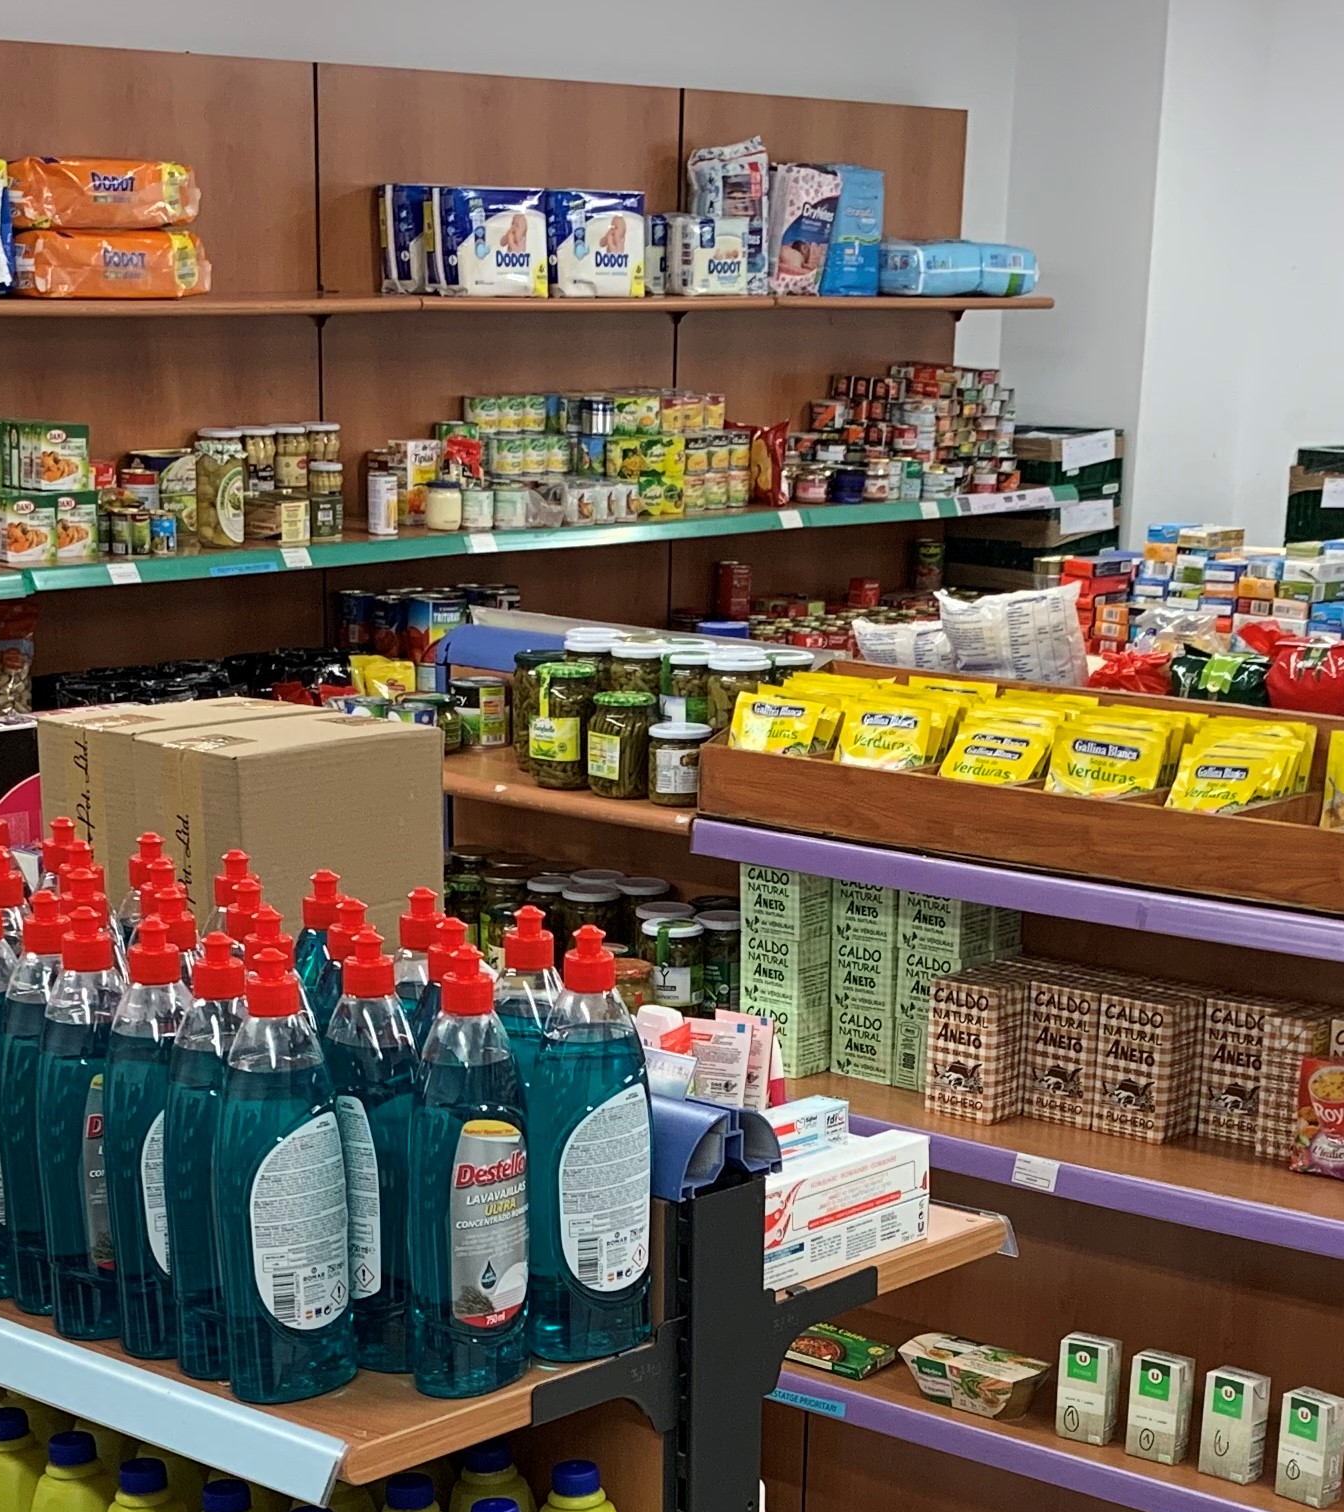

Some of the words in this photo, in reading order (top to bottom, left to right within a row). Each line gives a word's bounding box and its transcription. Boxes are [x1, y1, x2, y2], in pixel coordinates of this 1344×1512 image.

[91, 171, 135, 192] DODOT
[496, 249, 531, 269] DODOT
[595, 250, 629, 270] DODOT
[708, 259, 741, 275] DODOT
[49, 432, 64, 441] DANI
[16, 503, 32, 512] DANI
[853, 734, 912, 753] Verduras
[1074, 739, 1106, 756] Gallina
[1108, 744, 1138, 760] Blanca
[952, 760, 1011, 780] Verduras
[1067, 763, 1136, 786] Verduras
[1184, 786, 1237, 801] Verduras
[838, 944, 882, 963] CALDO
[838, 960, 881, 974] NATURAL
[934, 988, 989, 1011] CALDO
[1035, 991, 1091, 1015] CALDO
[839, 1012, 882, 1031] CALDO
[933, 1008, 989, 1028] NATURAL
[1033, 1011, 1090, 1033] NATURAL
[839, 1027, 881, 1042] NATURAL
[937, 1093, 983, 1110] PUCHERO
[1036, 1096, 1082, 1114] PUCHERO
[455, 1150, 527, 1188] Destello
[466, 1180, 526, 1206] LAVAVAJILLAS
[485, 1198, 517, 1217] ULTRA
[456, 1213, 511, 1230] CONCENTRADO
